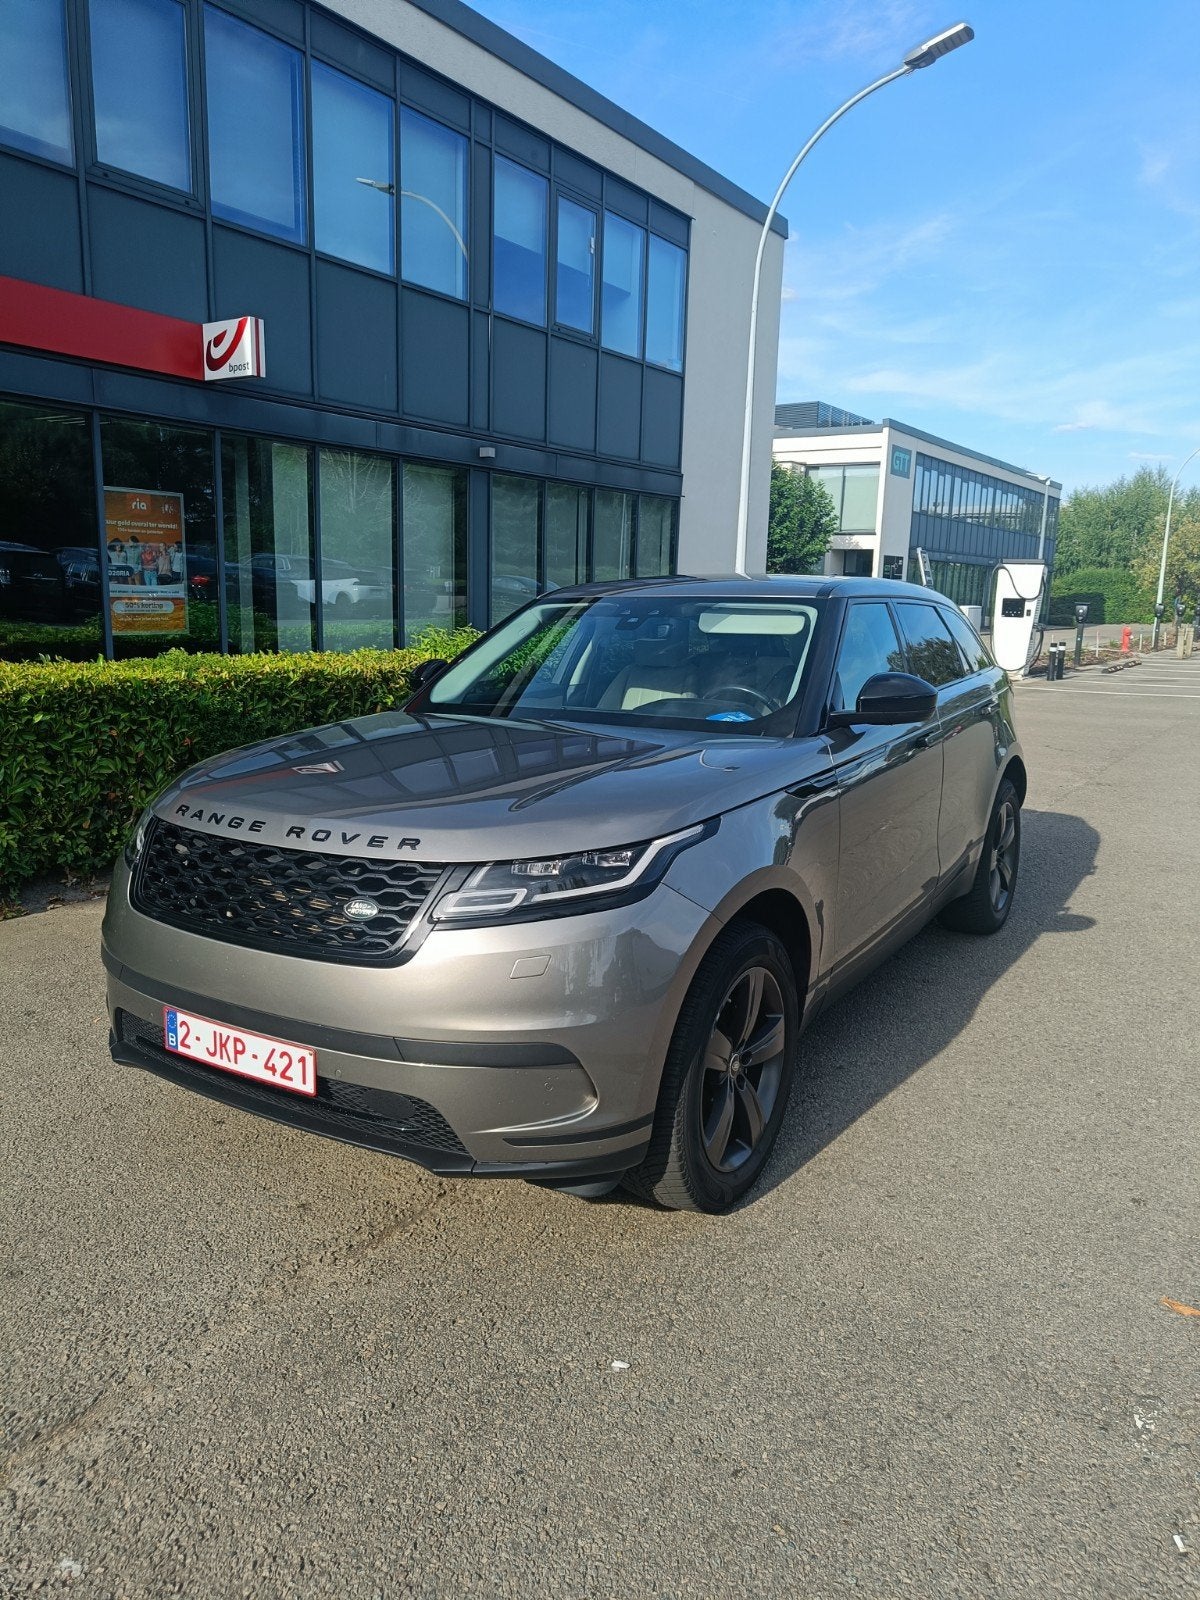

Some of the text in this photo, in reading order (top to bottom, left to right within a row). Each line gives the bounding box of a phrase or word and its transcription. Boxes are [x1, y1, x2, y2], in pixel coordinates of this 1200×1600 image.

[229, 362, 250, 374] bpost
[893, 450, 911, 473] GTT
[131, 498, 147, 511] ria
[131, 520, 148, 528] overal
[141, 601, 164, 609] korting
[175, 804, 422, 850] RANGE ROVER
[168, 1020, 308, 1086] B 2-JKP-421
